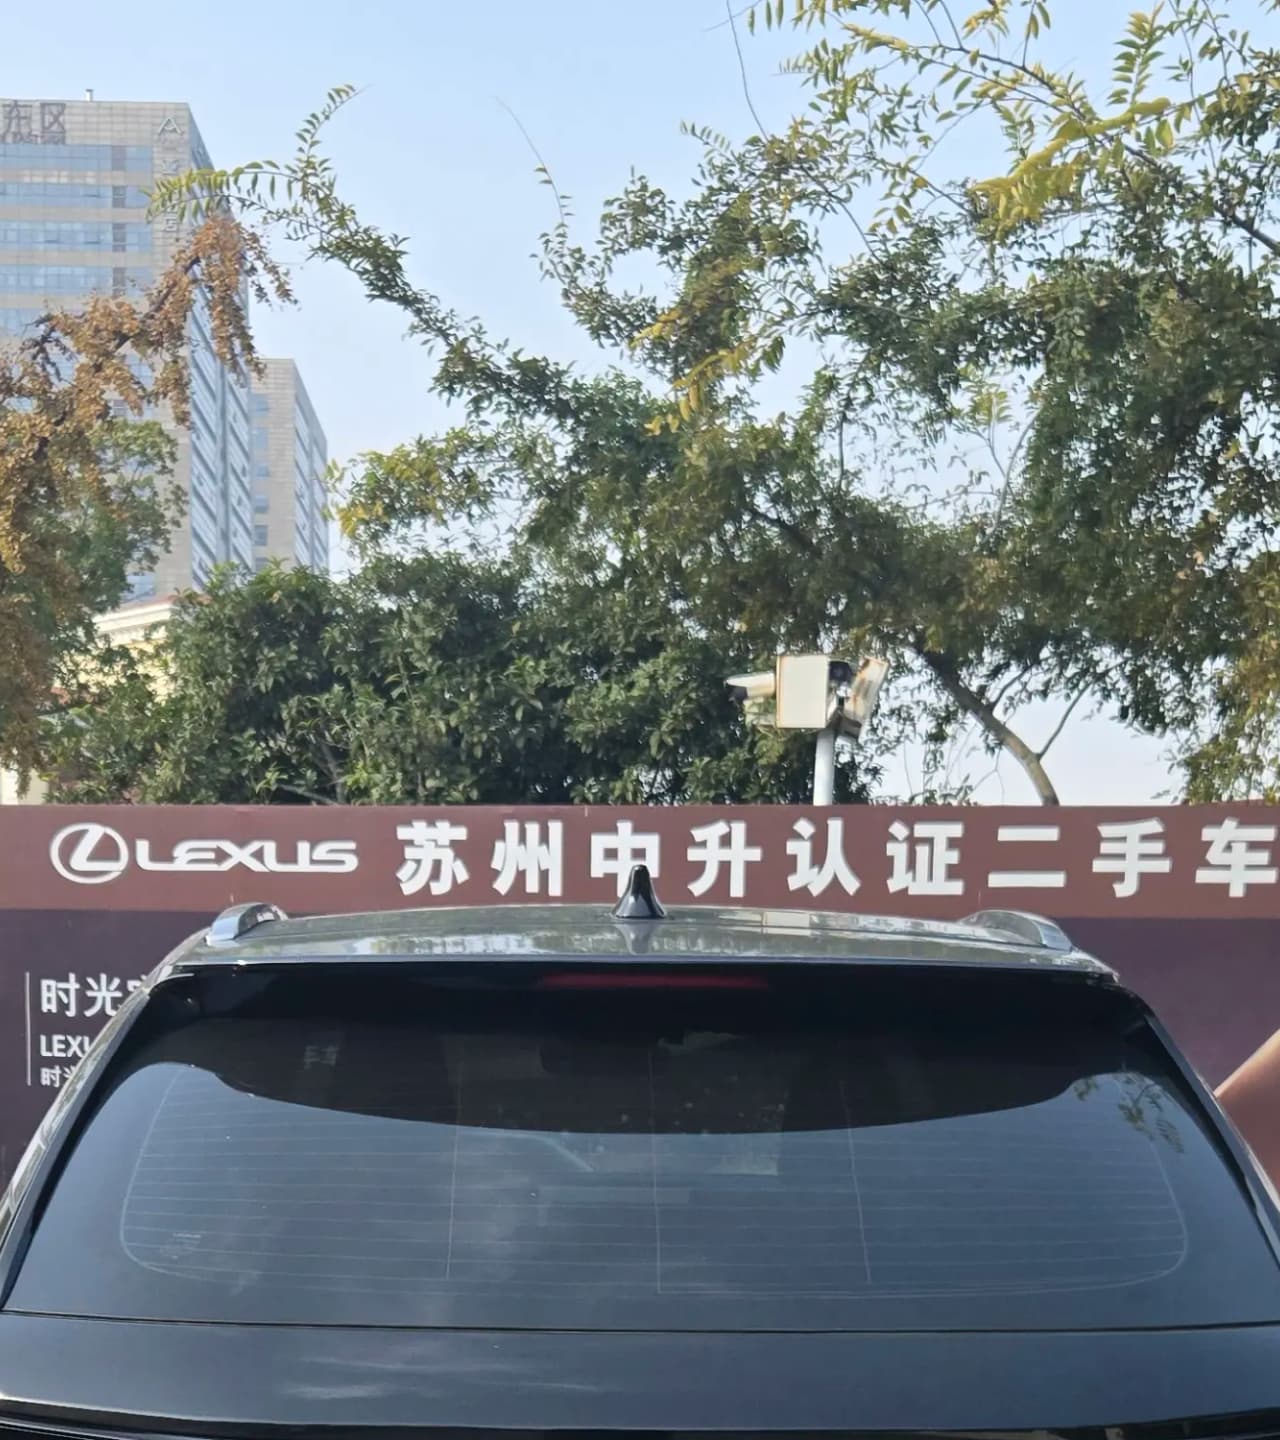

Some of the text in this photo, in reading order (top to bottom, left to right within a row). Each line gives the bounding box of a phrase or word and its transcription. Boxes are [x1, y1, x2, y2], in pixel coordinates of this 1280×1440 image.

[136, 839, 359, 873] LEXUS
[395, 817, 1280, 898] 苏州中升认证二手车
[40, 972, 148, 1017] 时光
